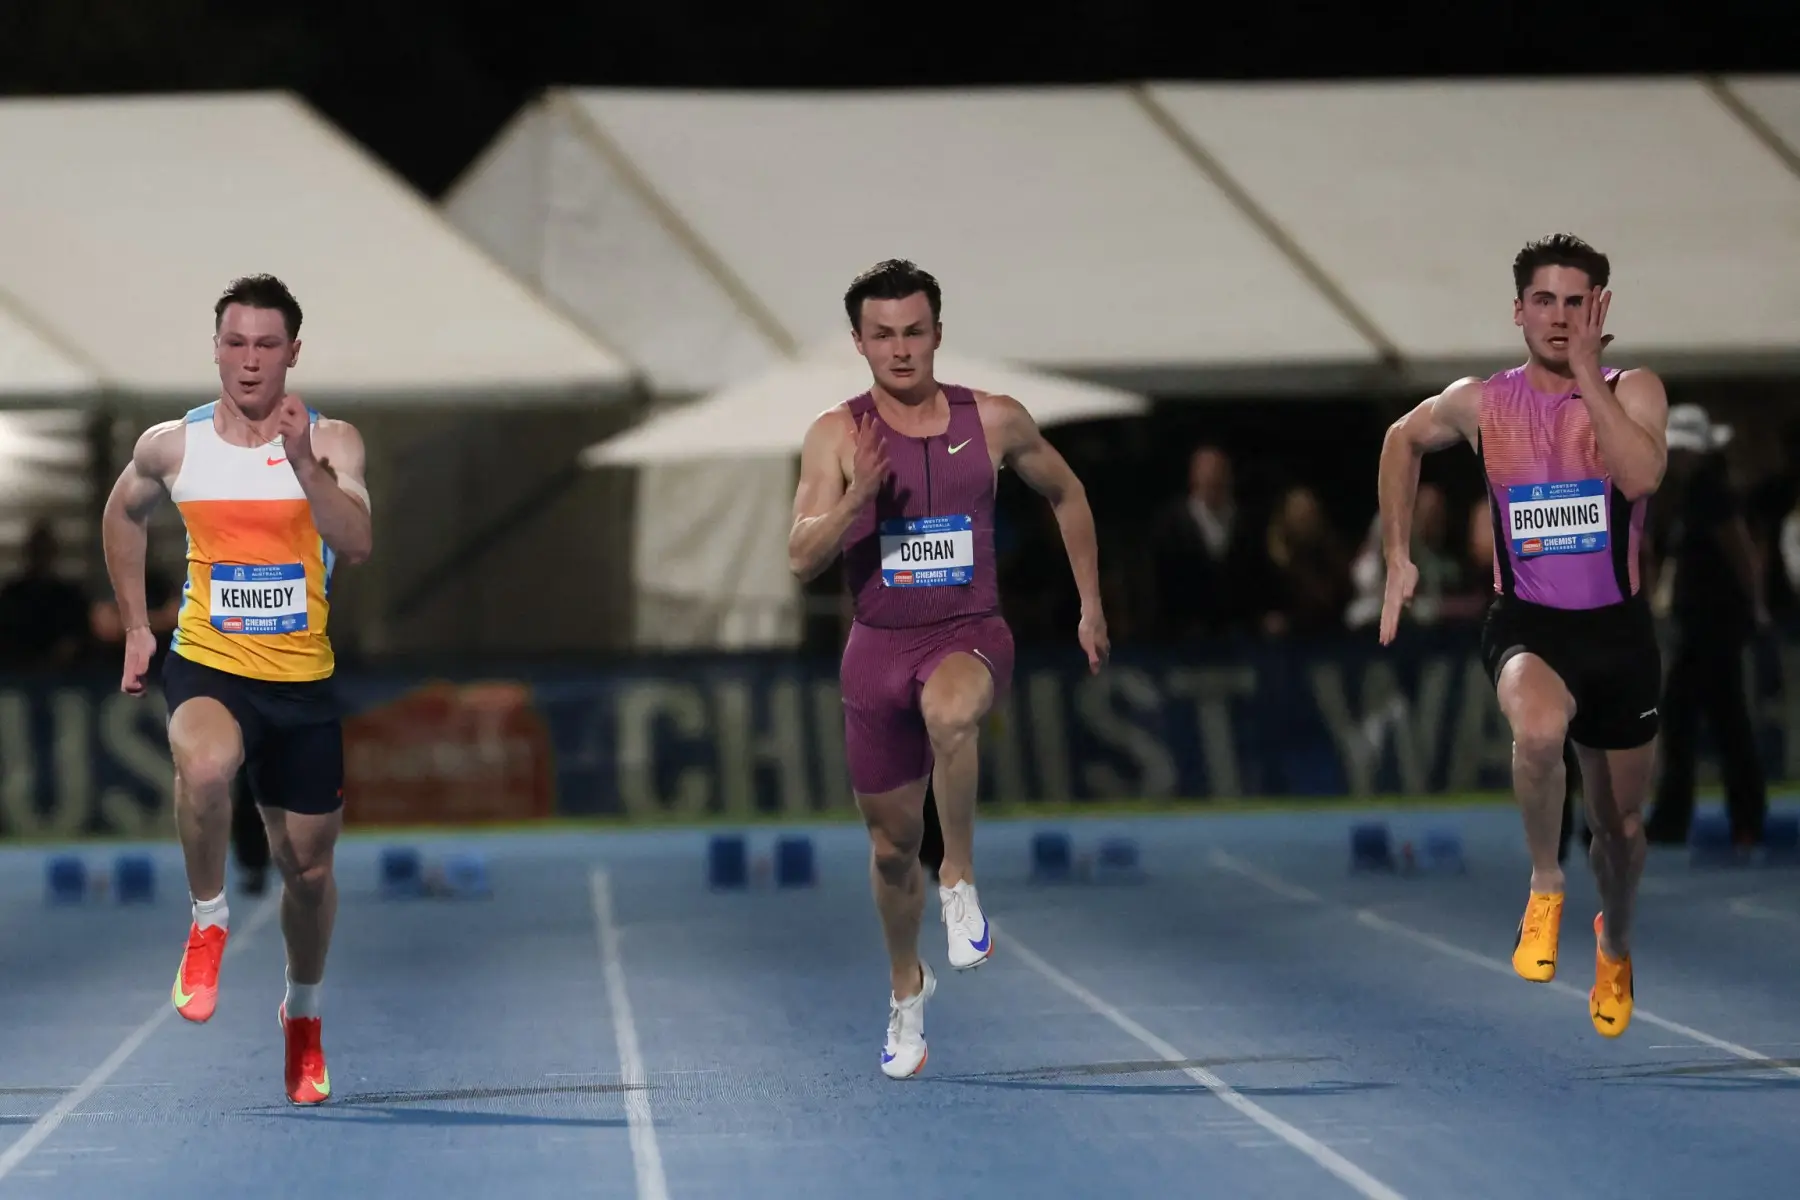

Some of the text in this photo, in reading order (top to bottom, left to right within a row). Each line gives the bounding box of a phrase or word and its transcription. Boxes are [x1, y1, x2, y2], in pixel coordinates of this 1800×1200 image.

[1514, 503, 1599, 530] BROWNING
[900, 539, 954, 562] DORAN
[1544, 537, 1577, 547] CHEMIST
[916, 570, 948, 579] CHEMIST
[221, 587, 294, 609] KENNEDY
[245, 618, 278, 626] CHEMIST
[615, 665, 1256, 820] CHIST
